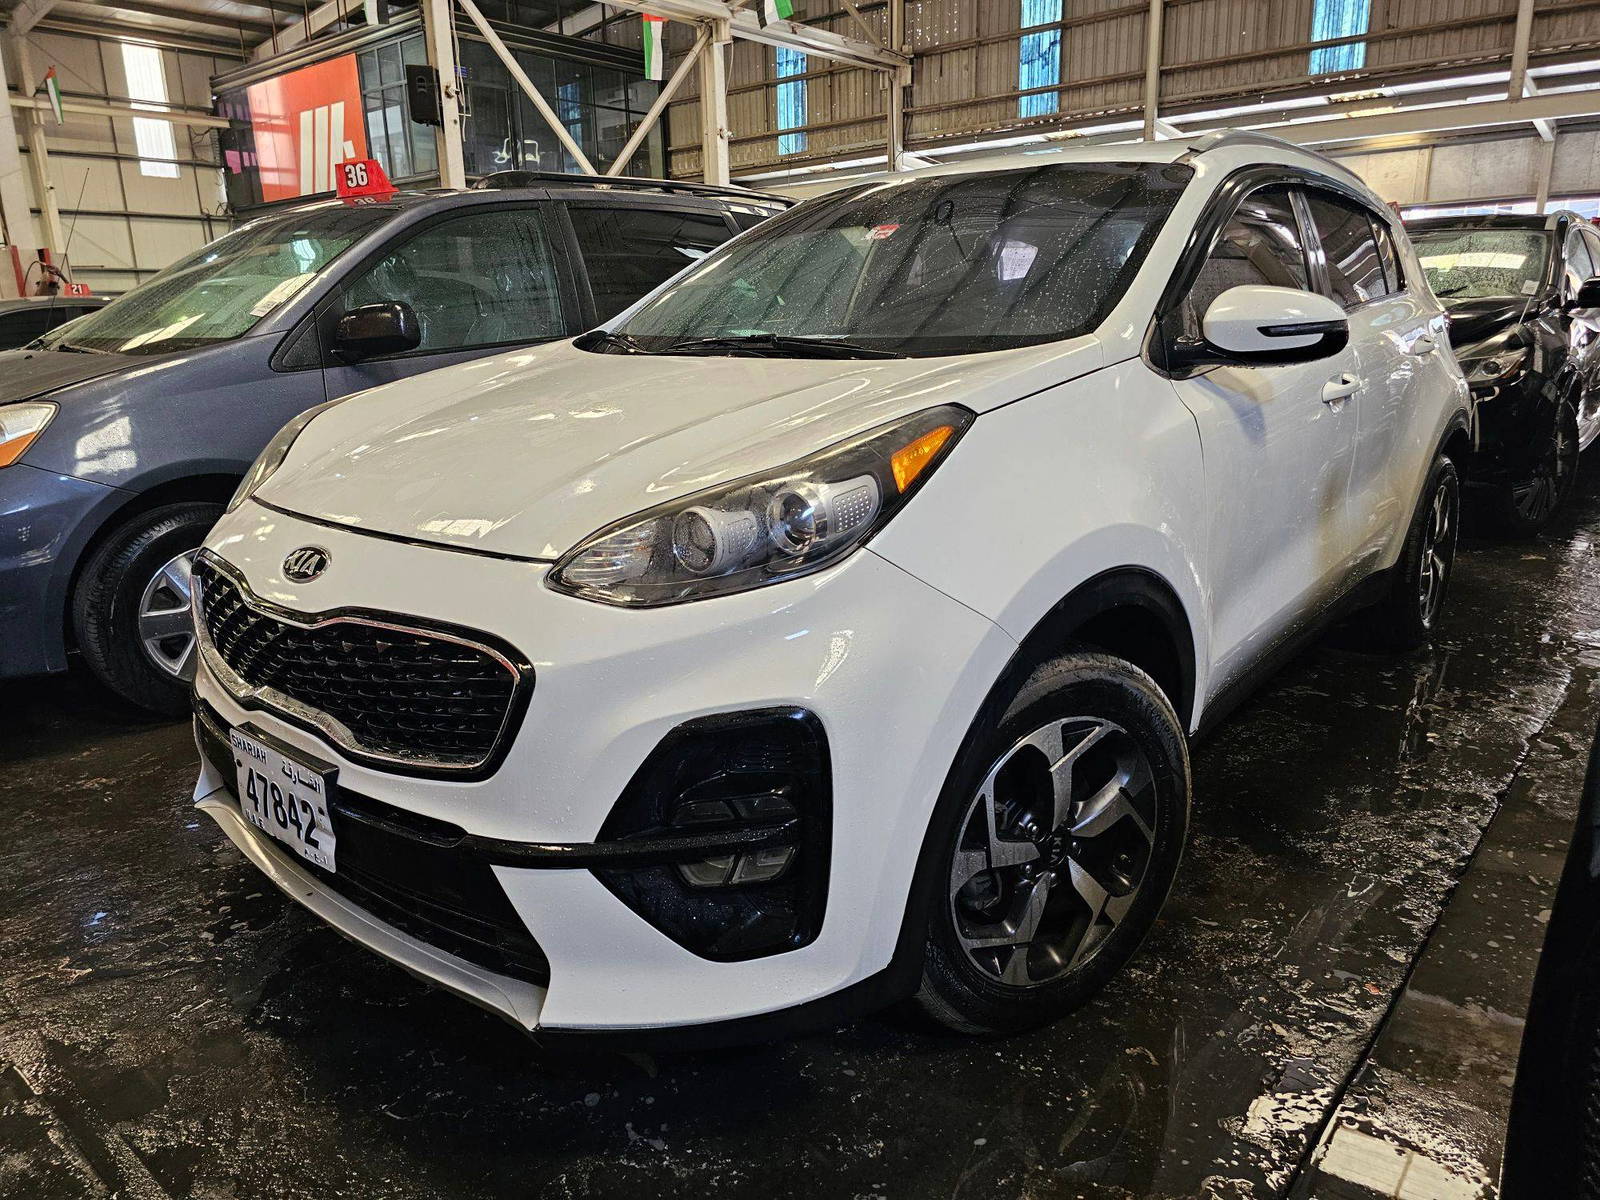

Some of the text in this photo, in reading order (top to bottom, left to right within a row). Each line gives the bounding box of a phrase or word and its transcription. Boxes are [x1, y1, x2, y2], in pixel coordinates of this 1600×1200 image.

[344, 162, 369, 188] 36
[71, 284, 83, 295] 21
[285, 550, 321, 576] KIA
[231, 733, 267, 765] SHARJAH
[246, 767, 321, 850] 47842
